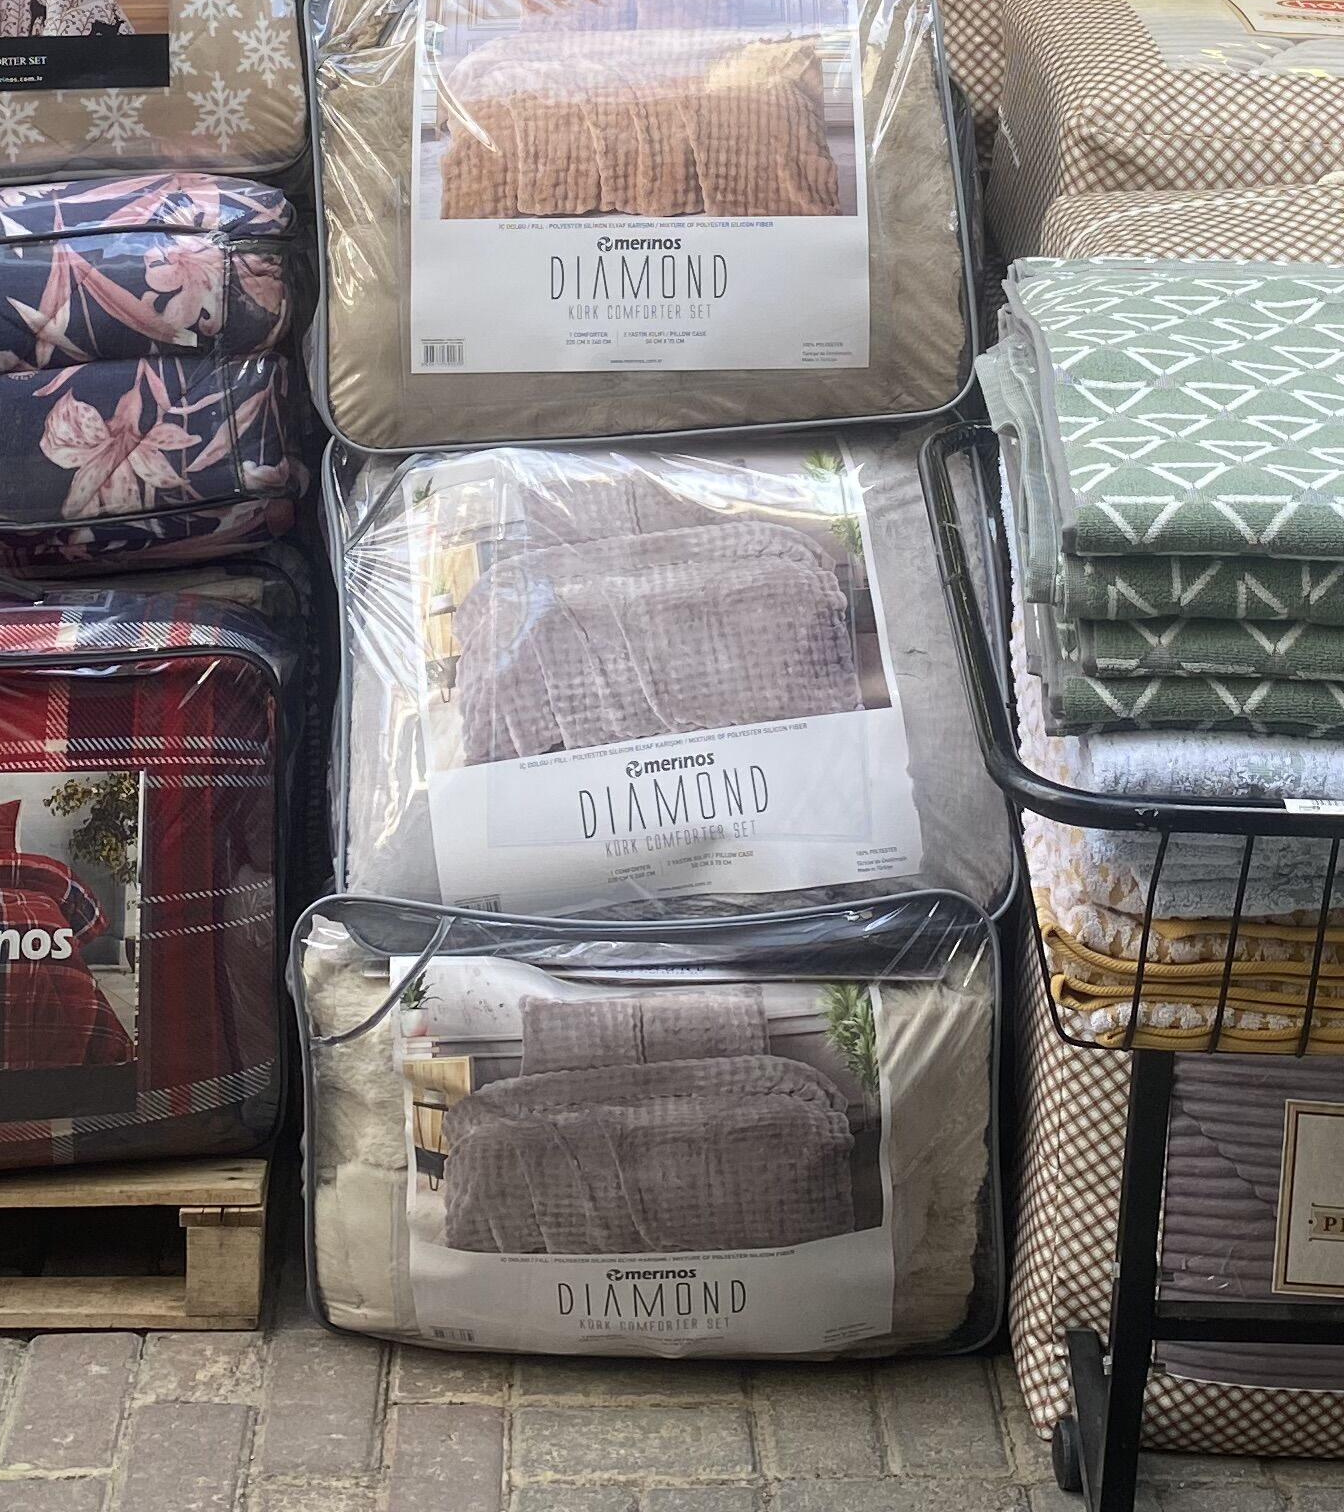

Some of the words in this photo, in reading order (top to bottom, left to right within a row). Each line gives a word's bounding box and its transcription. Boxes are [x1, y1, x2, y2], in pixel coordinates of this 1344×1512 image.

[28, 55, 48, 67] SET
[614, 237, 682, 251] merinos
[550, 254, 728, 300] DIAMOND
[607, 304, 682, 320] COMFORTER
[689, 303, 712, 319] SET
[644, 752, 715, 775] merinos
[578, 765, 769, 839] DIAMOND
[646, 826, 725, 852] COMFORTER
[733, 819, 756, 840] SET
[624, 1268, 697, 1281] merinos
[557, 1279, 746, 1318] DIAMOND
[618, 1317, 699, 1333] COMFORTER
[706, 1316, 731, 1330] SET
